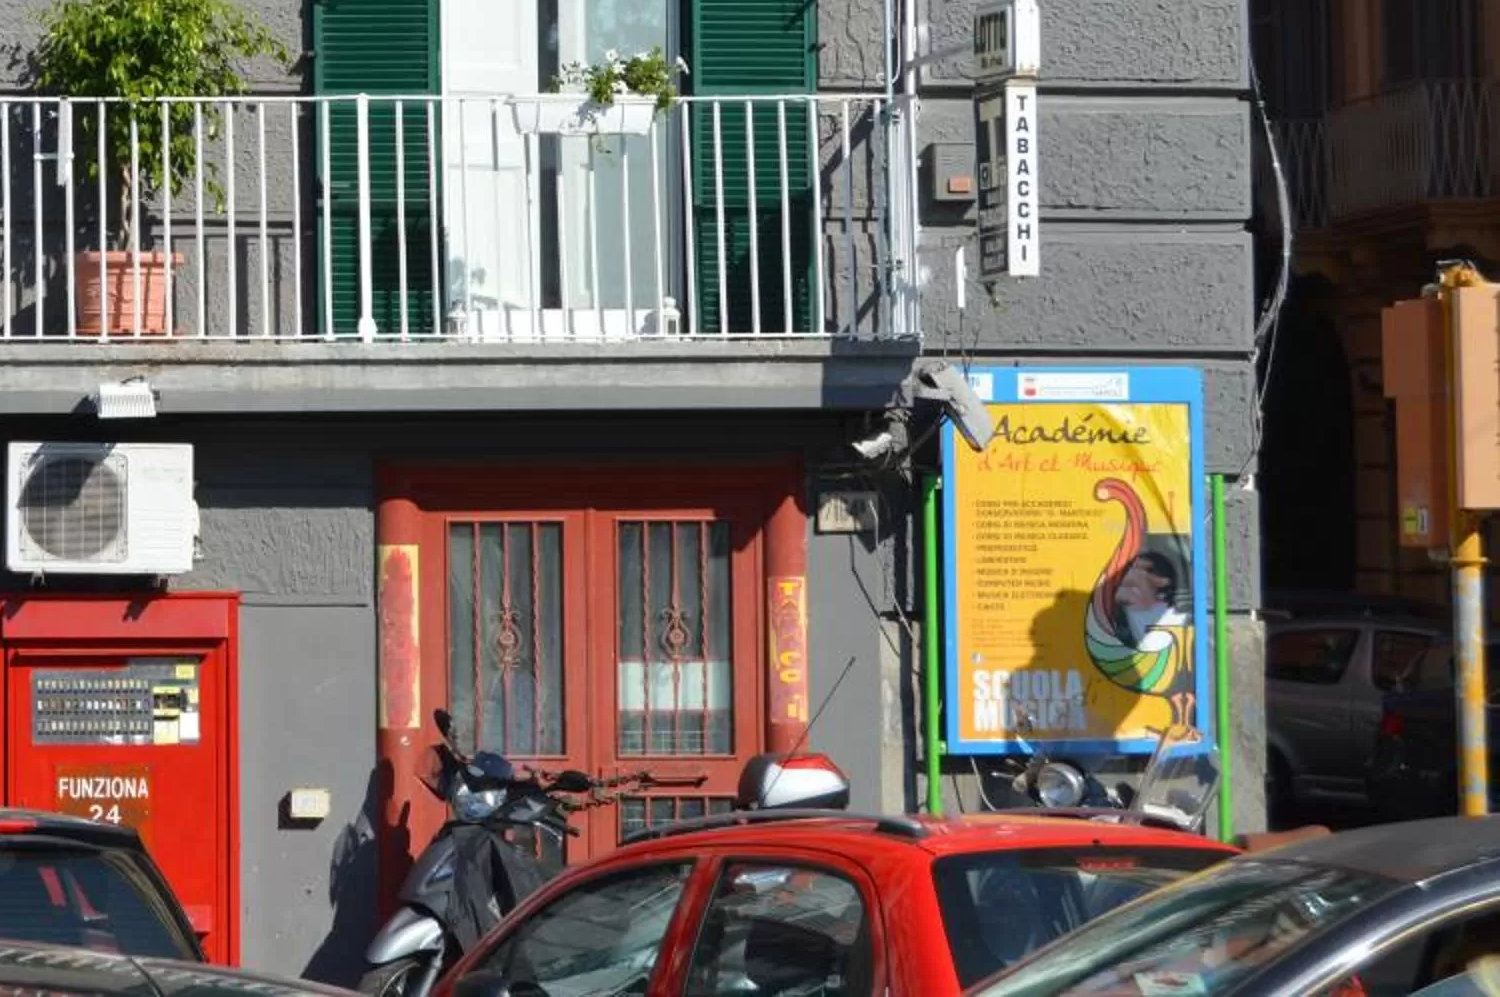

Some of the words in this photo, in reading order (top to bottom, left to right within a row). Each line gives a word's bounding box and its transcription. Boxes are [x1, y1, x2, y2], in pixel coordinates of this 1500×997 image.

[1014, 94, 1032, 262] TABACCHI
[991, 413, 1151, 444] Académie
[1067, 452, 1162, 483] Musique
[972, 668, 1084, 700] SCUOLA
[974, 700, 1088, 732] MUSICA
[58, 776, 149, 800] FUNZIONA
[88, 803, 123, 824] 24
